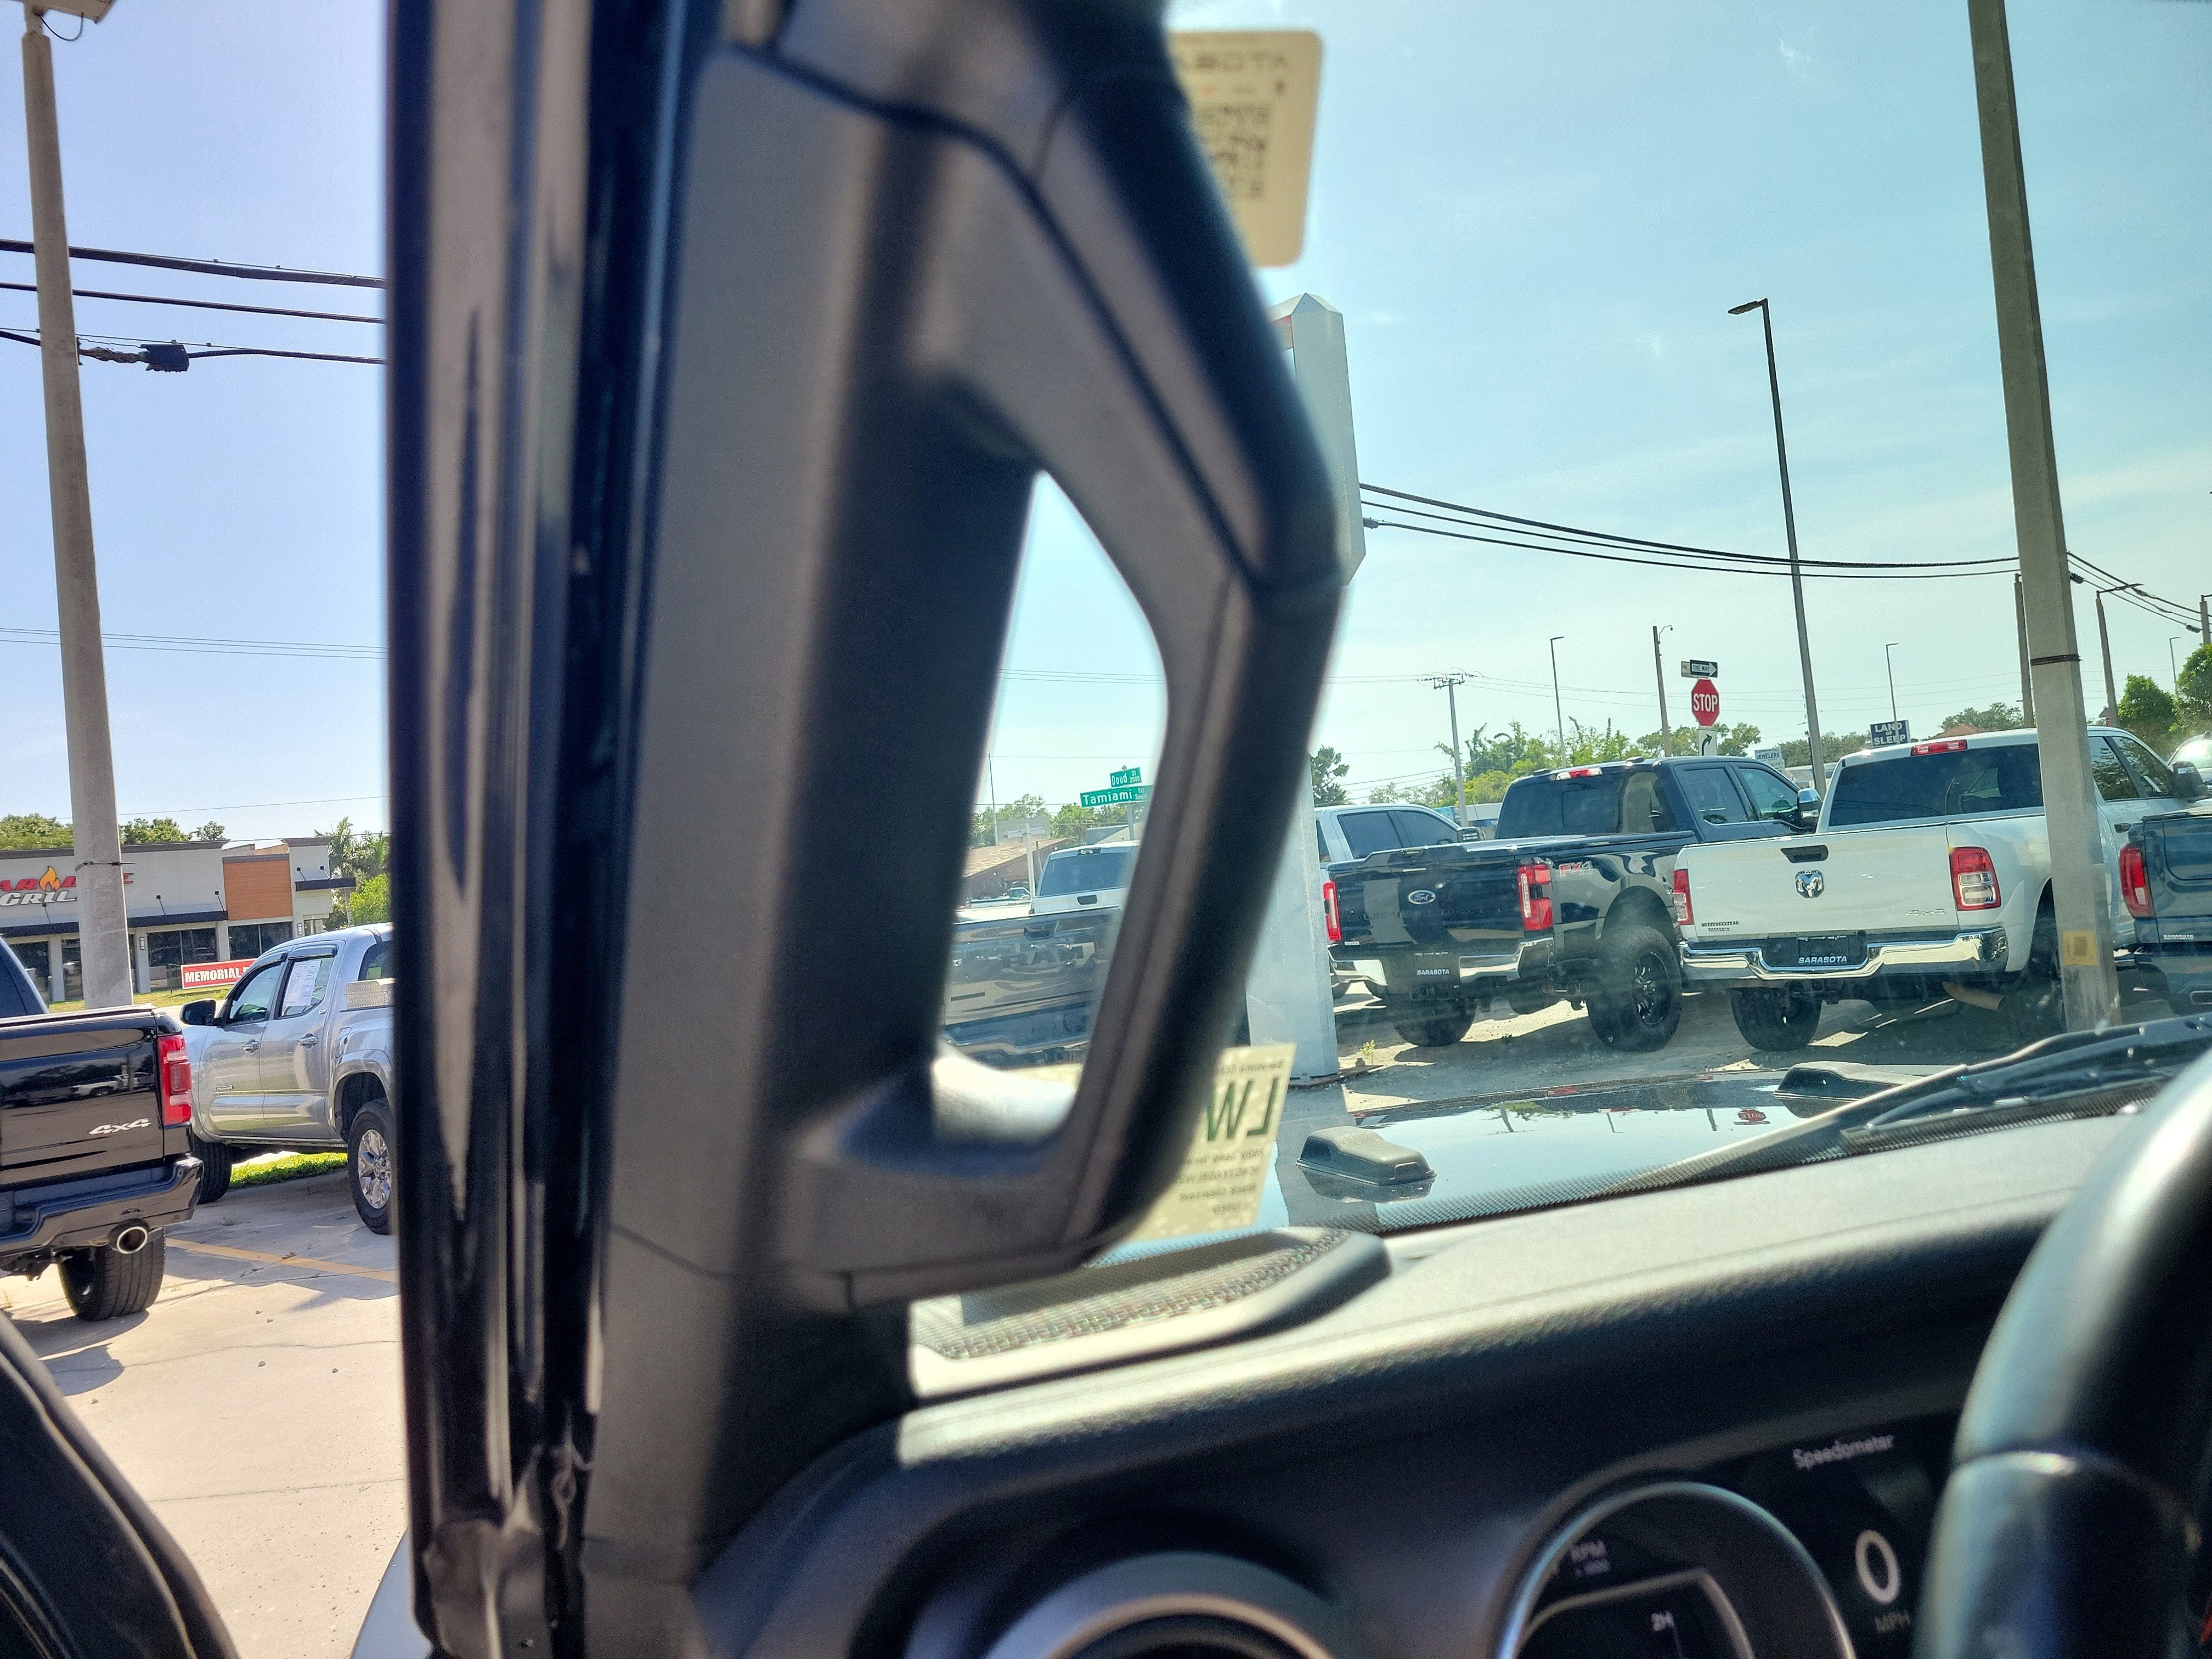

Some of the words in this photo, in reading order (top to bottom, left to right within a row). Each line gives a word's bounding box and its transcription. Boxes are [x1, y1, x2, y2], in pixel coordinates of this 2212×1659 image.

[1693, 693, 1718, 712] STOP
[1875, 722, 1903, 732] LAND
[1874, 734, 1906, 744] SLEEP
[1111, 772, 1127, 786] Doud
[1083, 789, 1132, 805] Tamiami
[1559, 861, 1593, 876] FX4
[1414, 893, 1429, 901] Ford
[1002, 945, 1085, 968] RAM
[185, 968, 241, 983] MEMORIAL
[88, 1118, 152, 1135] 4x4
[1792, 1435, 1894, 1469] Speedometer
[1855, 1530, 1901, 1604] 0
[1875, 1611, 1910, 1634] MPH
